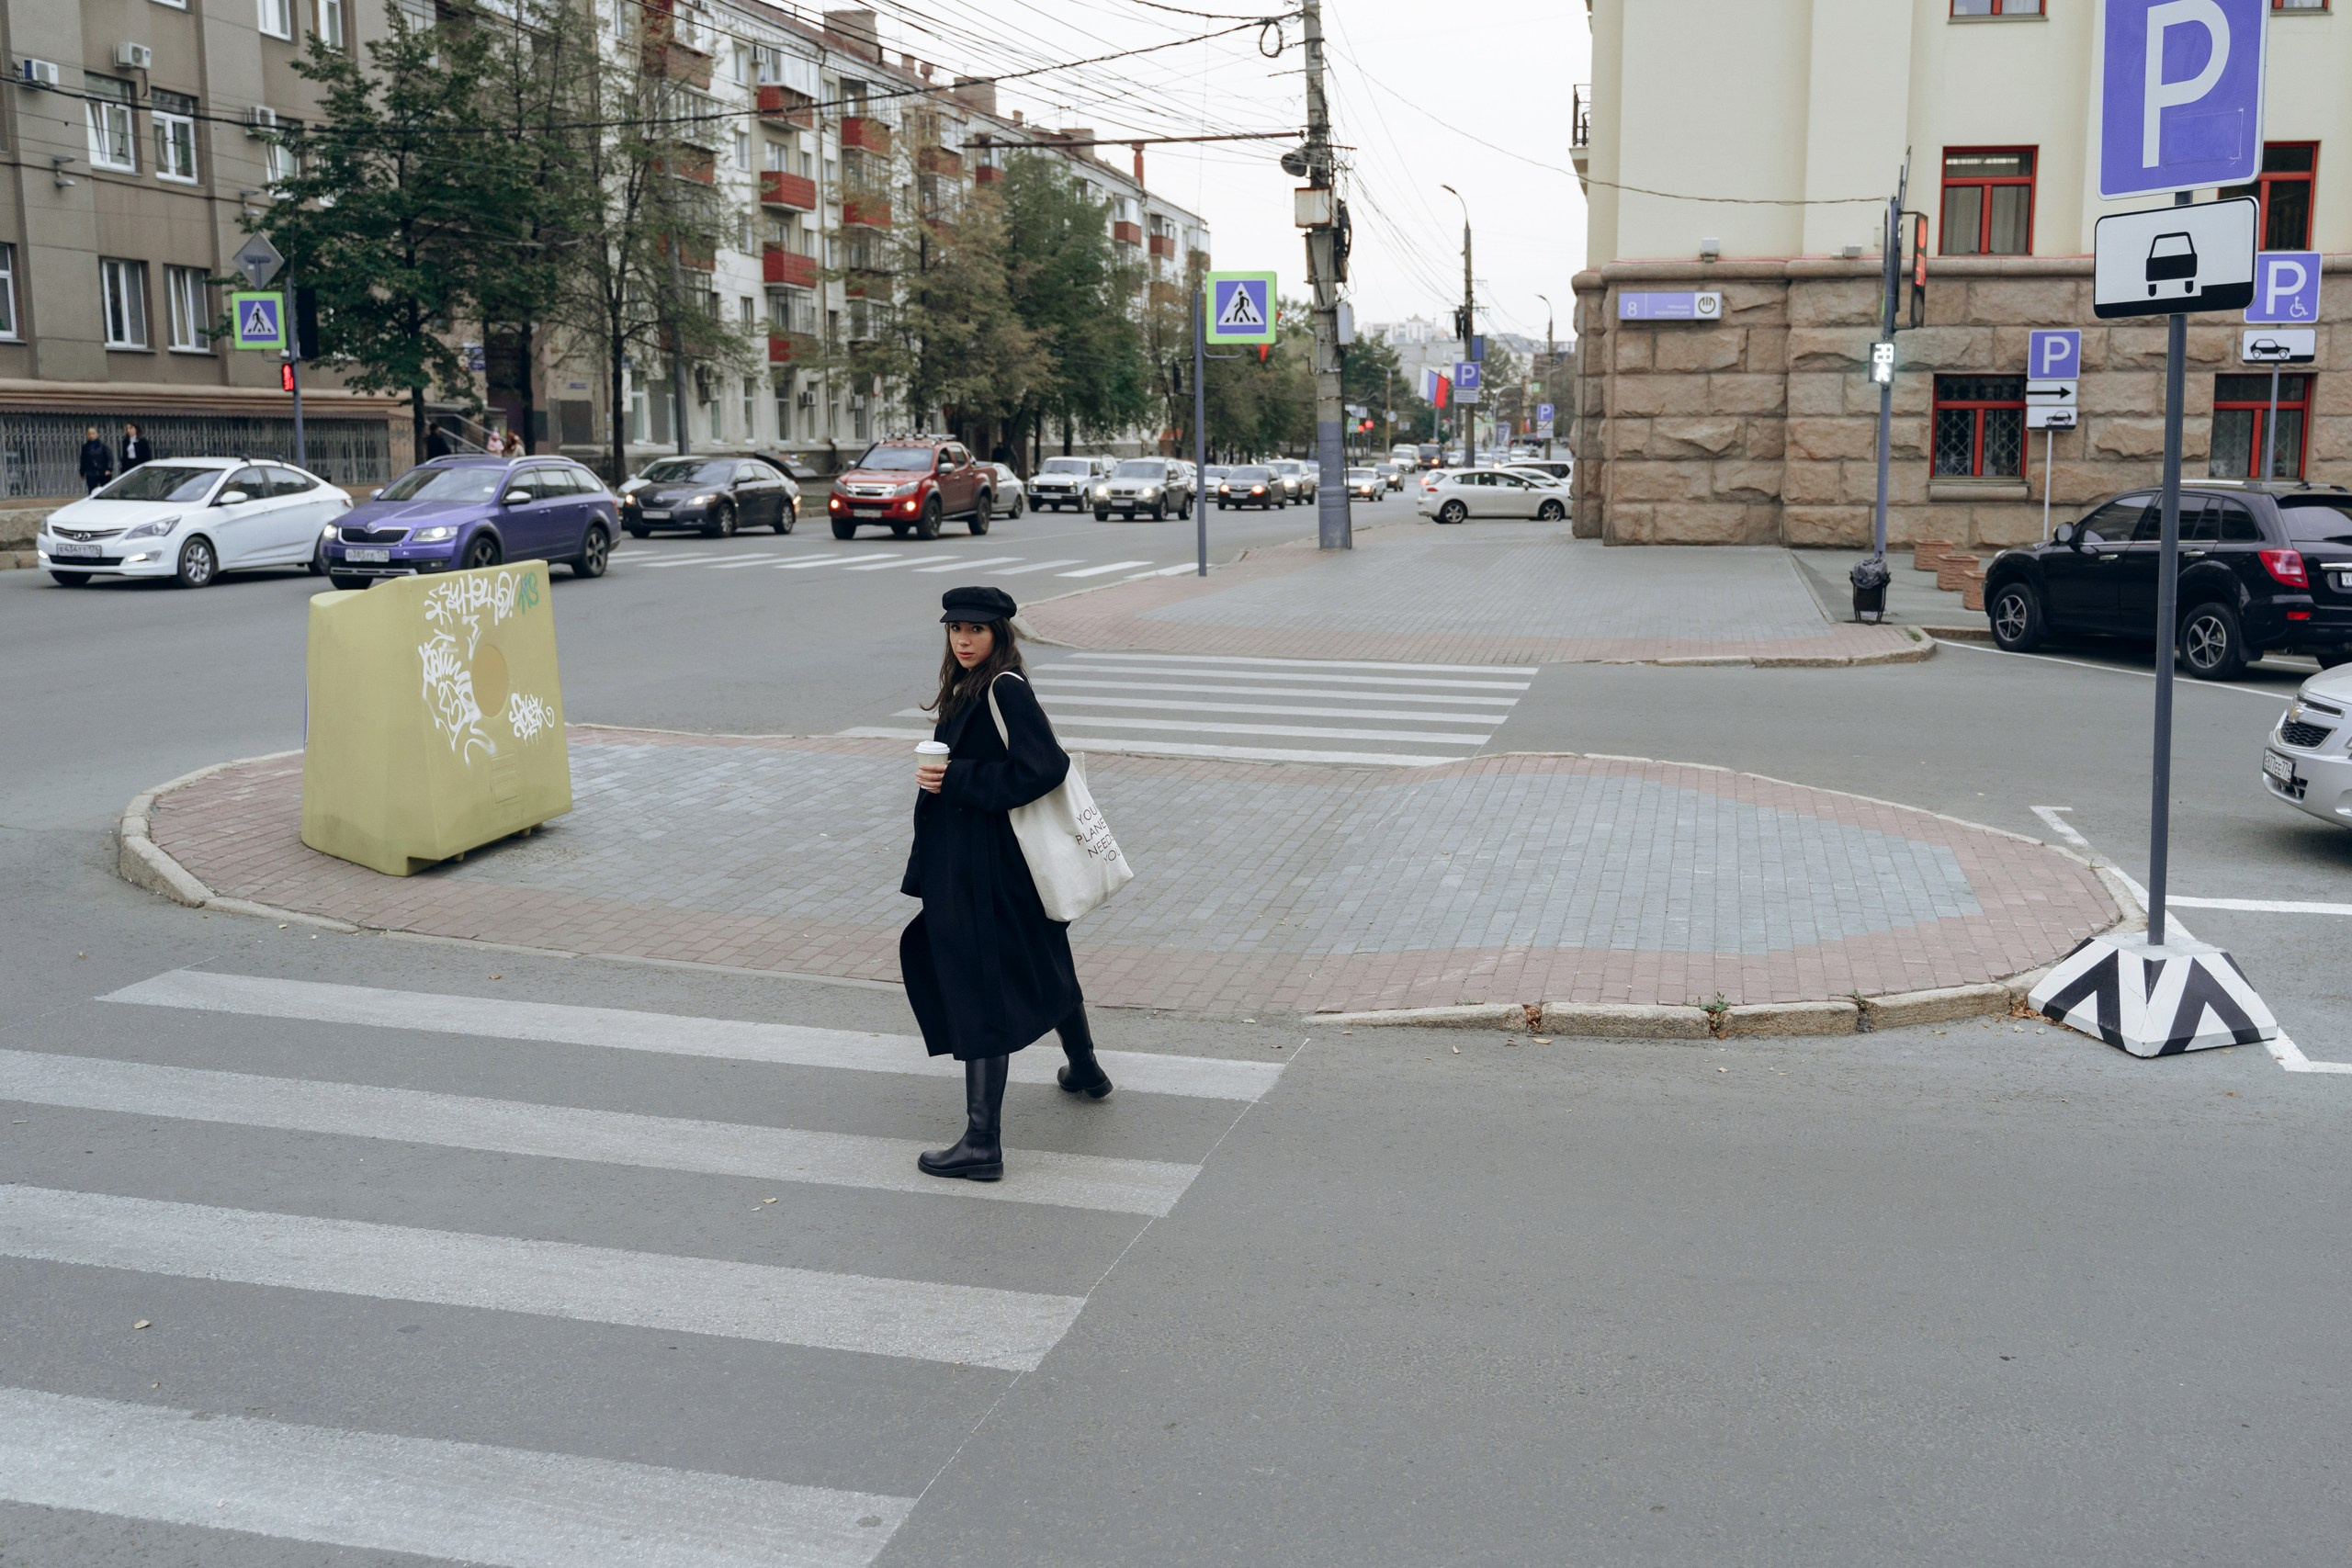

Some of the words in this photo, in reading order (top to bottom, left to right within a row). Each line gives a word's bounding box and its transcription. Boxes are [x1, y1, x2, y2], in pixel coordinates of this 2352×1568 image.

[2143, 0, 2231, 168] P
[2266, 260, 2307, 315] P
[1627, 301, 1637, 317] 8
[2042, 336, 2071, 375] P
[1462, 365, 1476, 386] P
[1541, 405, 1551, 420] P
[1077, 804, 1097, 825] YOU
[1075, 818, 1106, 845] PLANE
[1088, 834, 1114, 858] NEED
